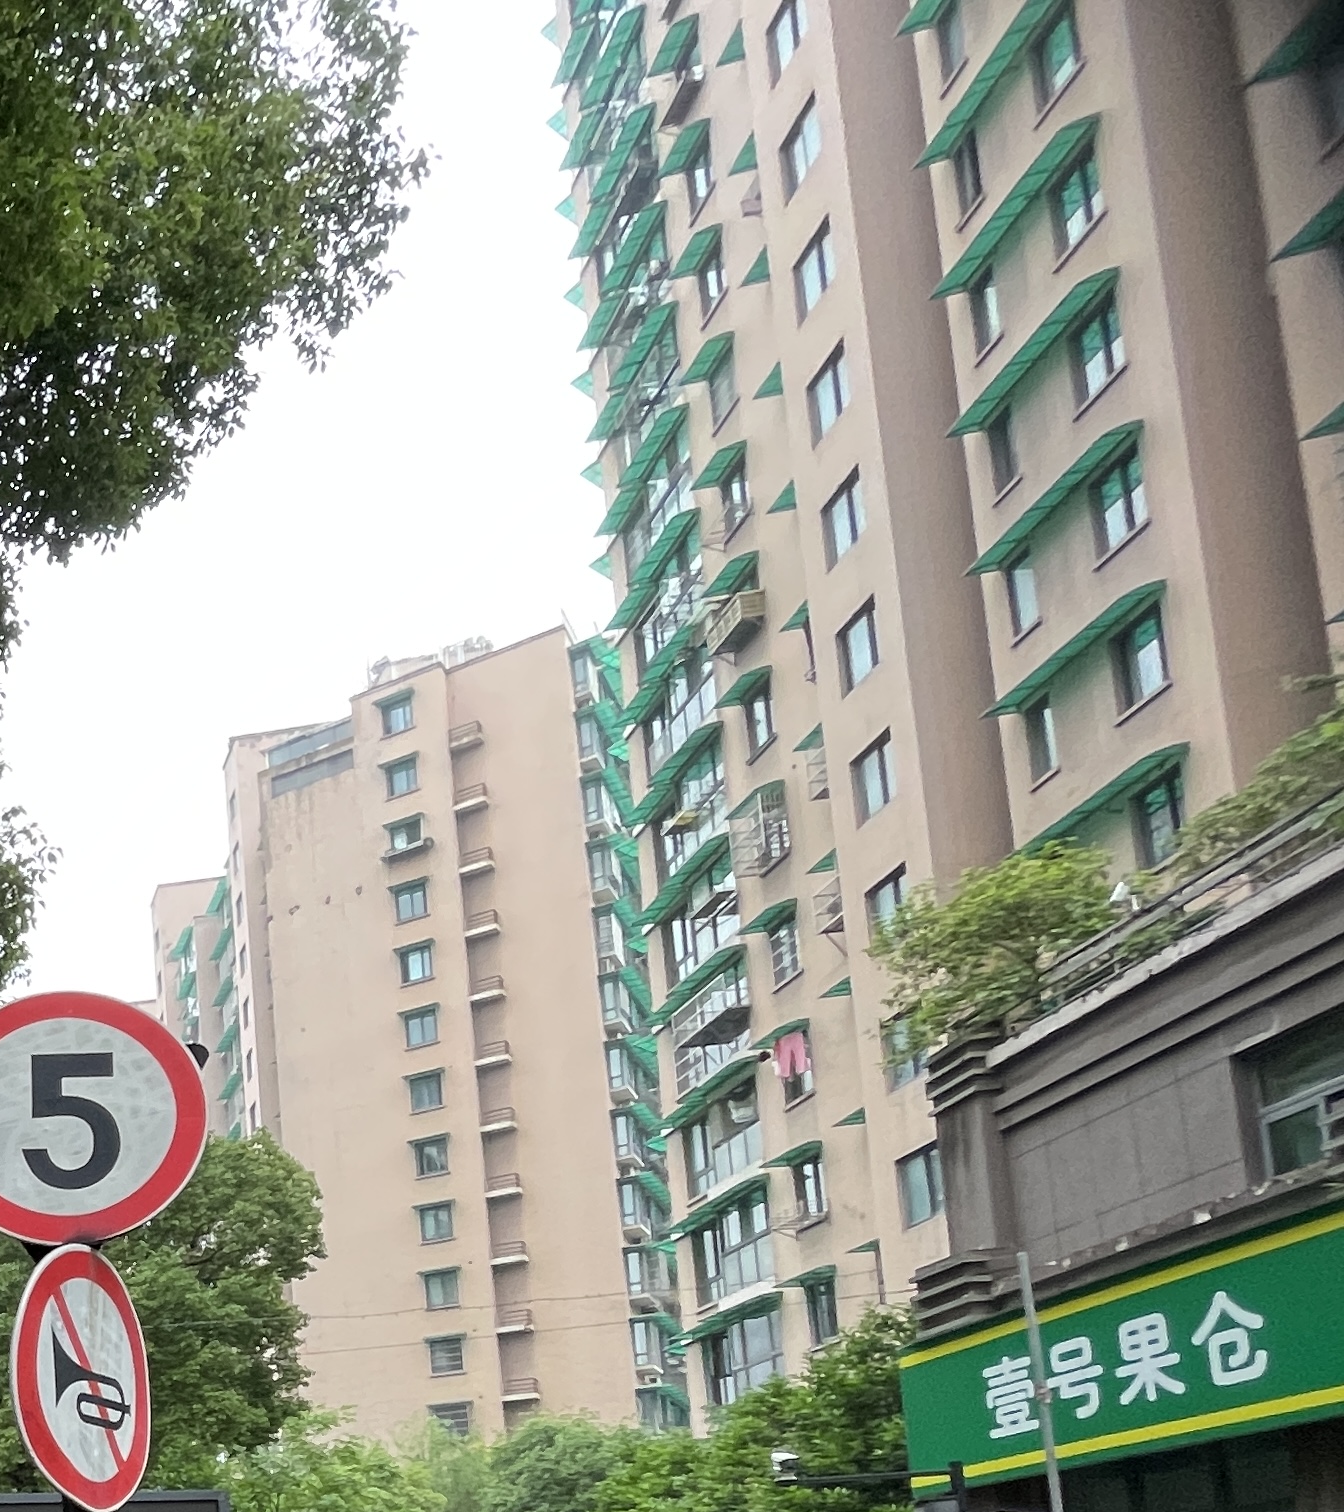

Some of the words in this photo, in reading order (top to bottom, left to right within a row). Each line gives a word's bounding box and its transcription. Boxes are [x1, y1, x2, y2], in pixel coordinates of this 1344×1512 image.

[21, 1052, 121, 1190] 5
[982, 1290, 1269, 1439] 壹号果仓
